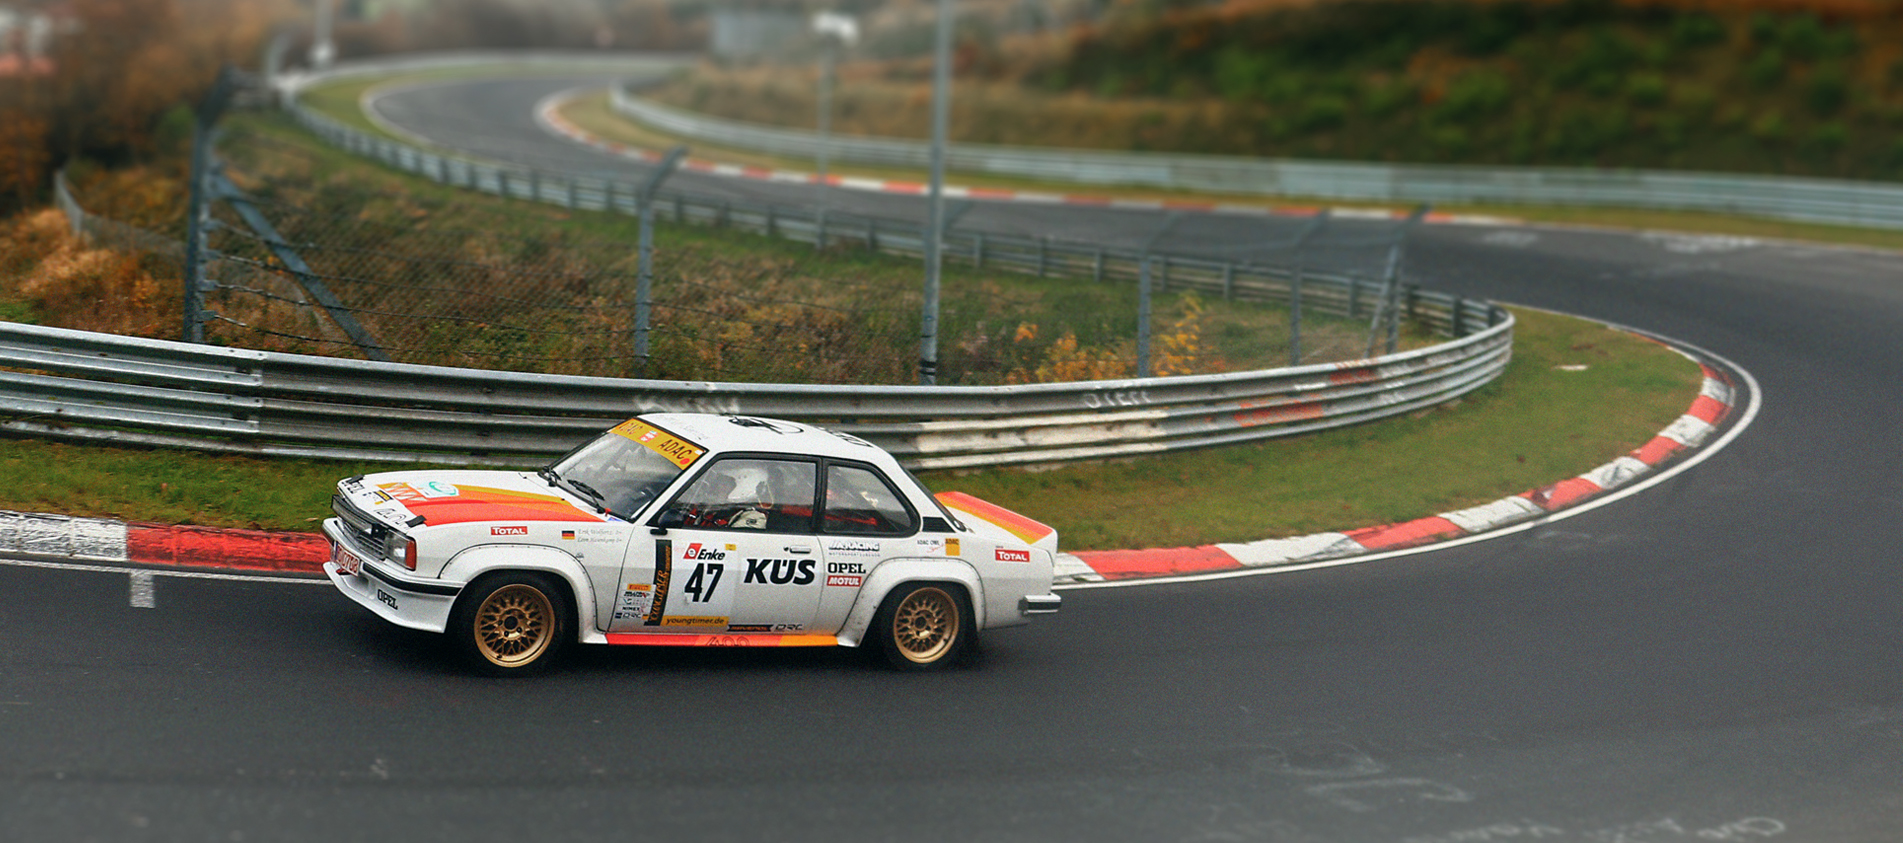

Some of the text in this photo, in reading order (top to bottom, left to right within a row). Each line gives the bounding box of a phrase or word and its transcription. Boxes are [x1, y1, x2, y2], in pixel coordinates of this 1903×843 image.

[657, 439, 692, 459] ADAC
[493, 527, 526, 535] TOTAL
[697, 548, 726, 561] Enke
[997, 551, 1028, 561] TOTAL
[743, 558, 816, 585] KÜS
[827, 562, 866, 574] OPEL
[684, 562, 724, 603] 47
[828, 576, 860, 586] MOTUL
[377, 588, 398, 611] OPEL
[666, 616, 725, 625] youngtimer.de
